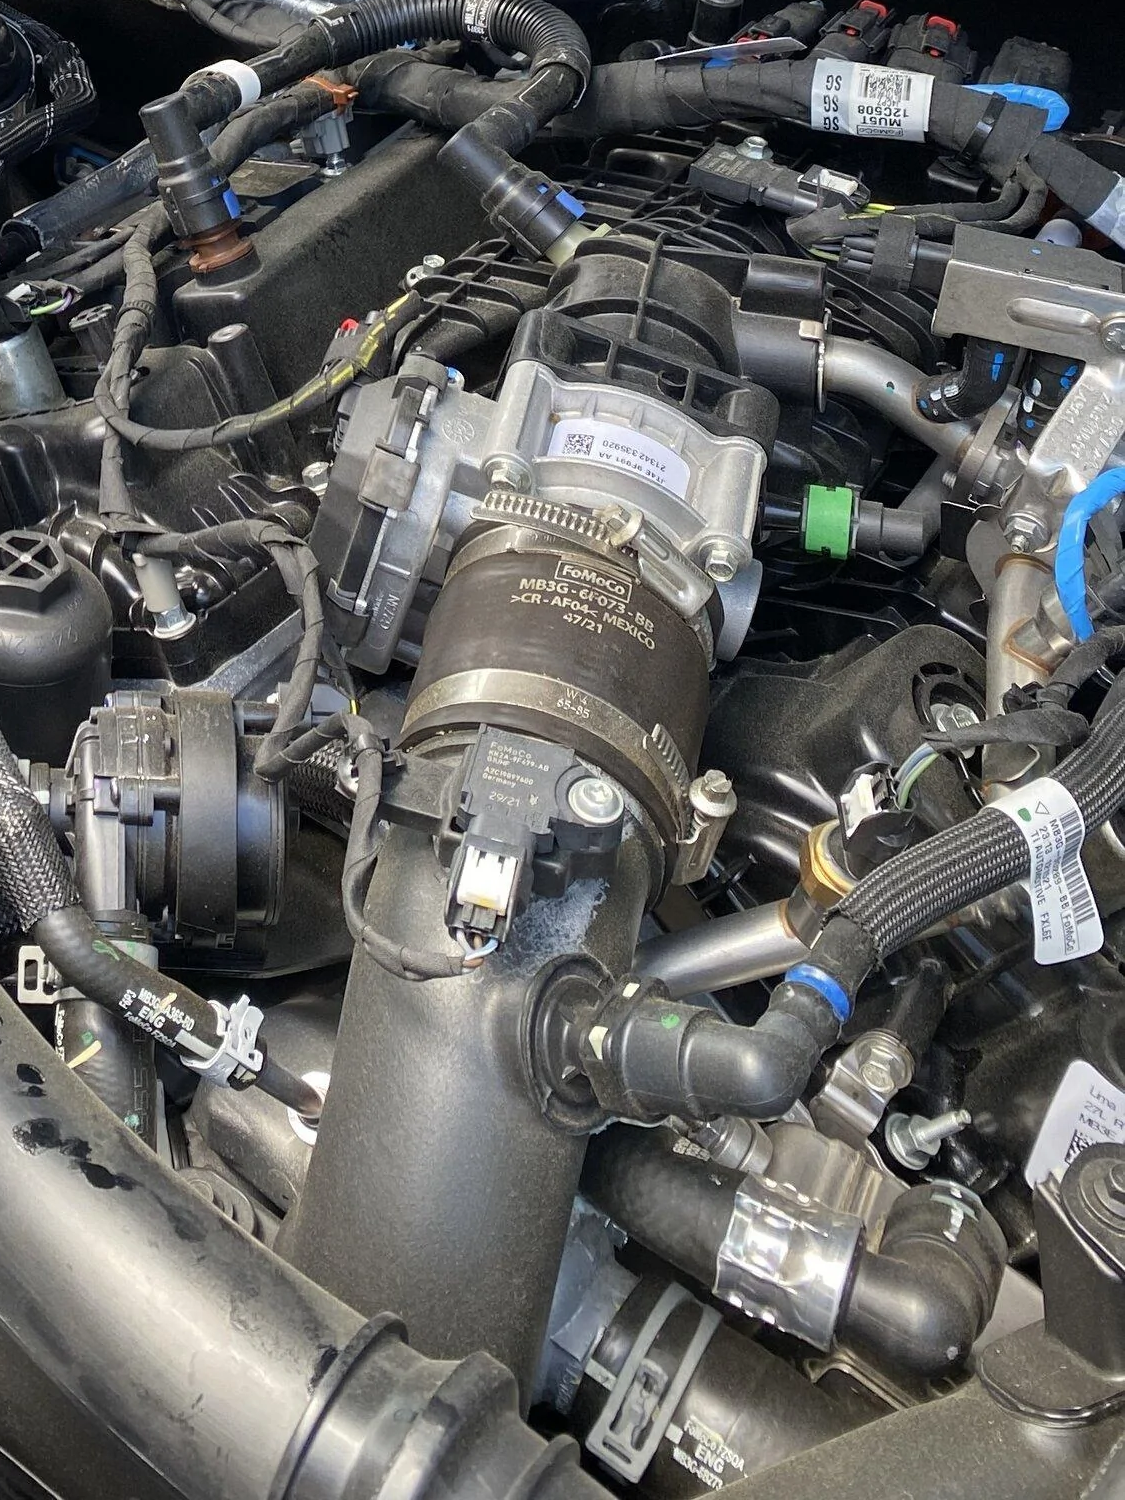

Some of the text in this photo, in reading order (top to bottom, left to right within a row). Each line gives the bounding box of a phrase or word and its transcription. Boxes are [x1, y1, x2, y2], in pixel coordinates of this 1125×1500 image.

[826, 74, 842, 91] SG
[823, 94, 839, 112] SG
[857, 105, 909, 117] 12C508
[823, 117, 840, 131] SG
[598, 451, 612, 460] AA
[561, 564, 626, 596] FoMoCo
[603, 614, 655, 651] MEXICO
[490, 741, 532, 759] FoMoCo
[489, 791, 520, 806] 29/21
[1034, 844, 1046, 905] AUTOMOTIVE
[1065, 914, 1075, 952] FoMoCo
[138, 1007, 164, 1030] ENG
[694, 1443, 726, 1474] ENG
